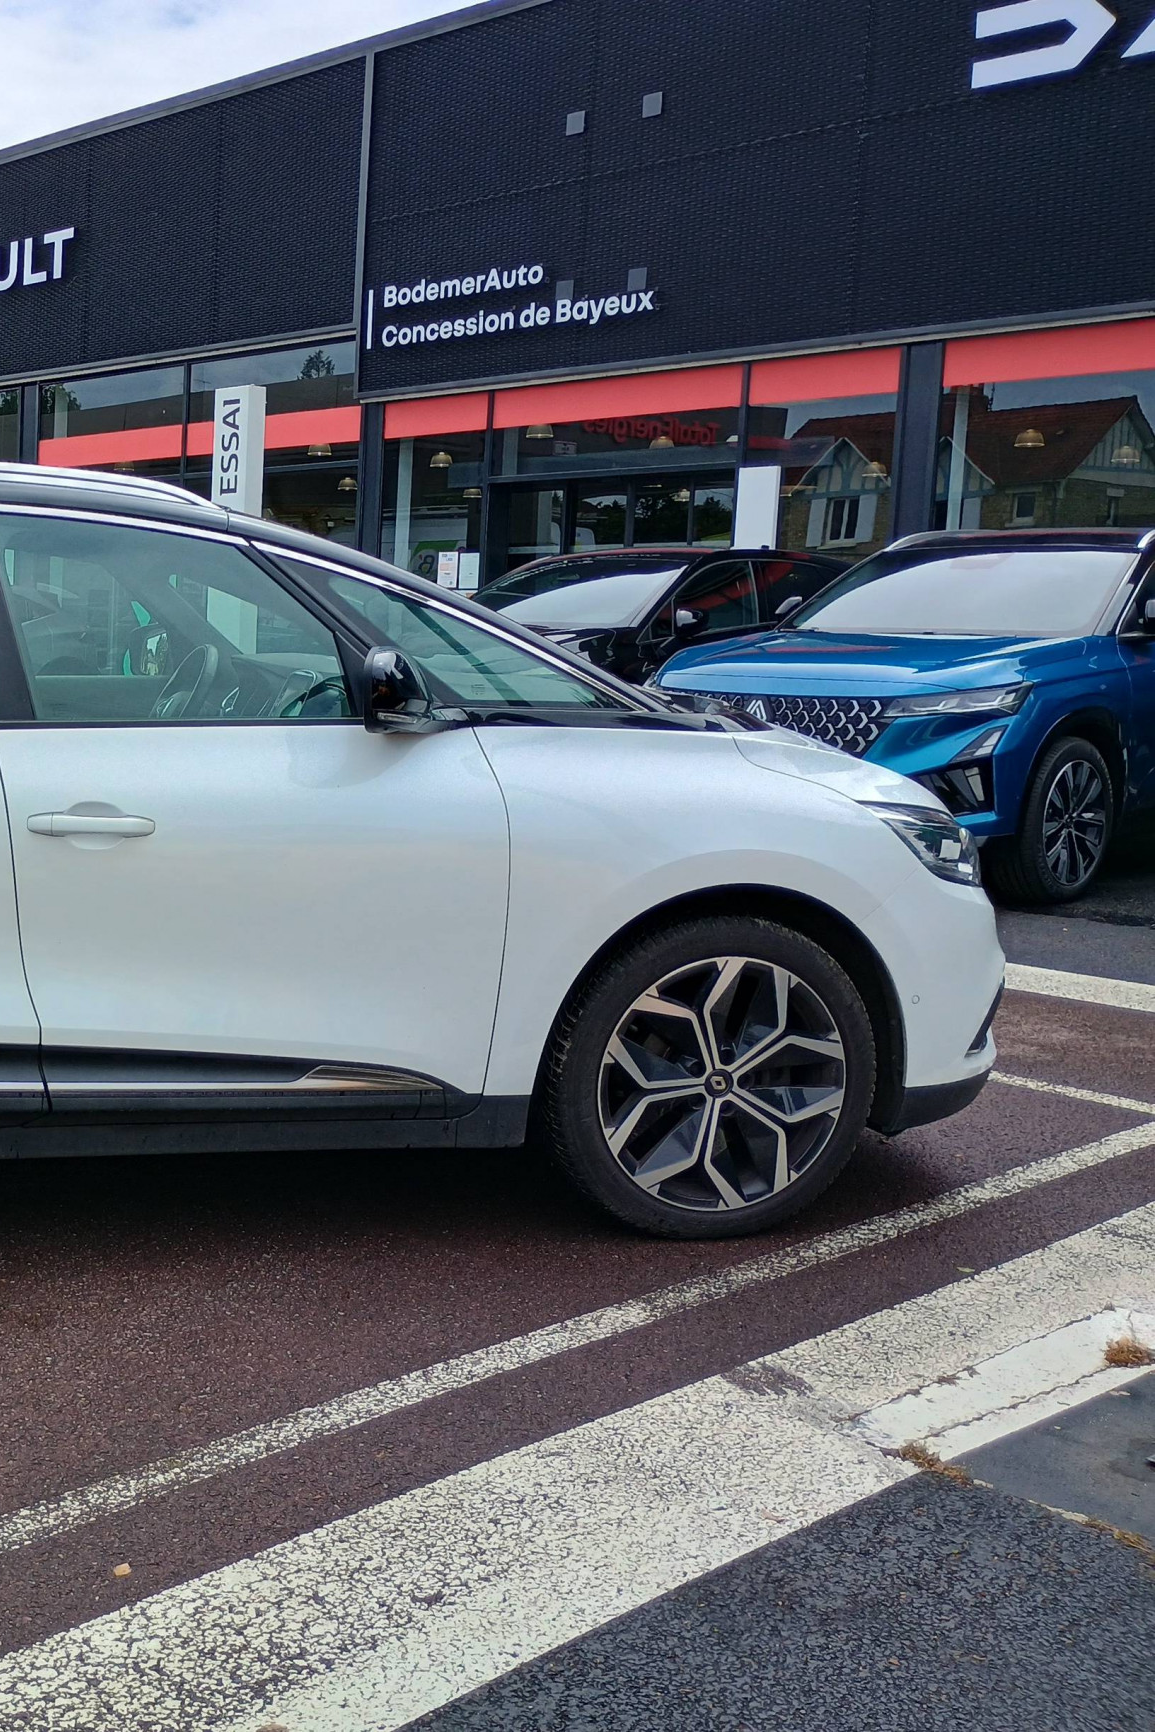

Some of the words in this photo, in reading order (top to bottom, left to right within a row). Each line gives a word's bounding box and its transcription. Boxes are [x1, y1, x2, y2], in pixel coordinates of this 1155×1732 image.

[383, 264, 544, 308] BodemerAuto
[381, 309, 515, 347] Concession
[519, 302, 550, 328] de
[555, 290, 655, 325] Bayeux
[219, 398, 241, 496] ESSAI
